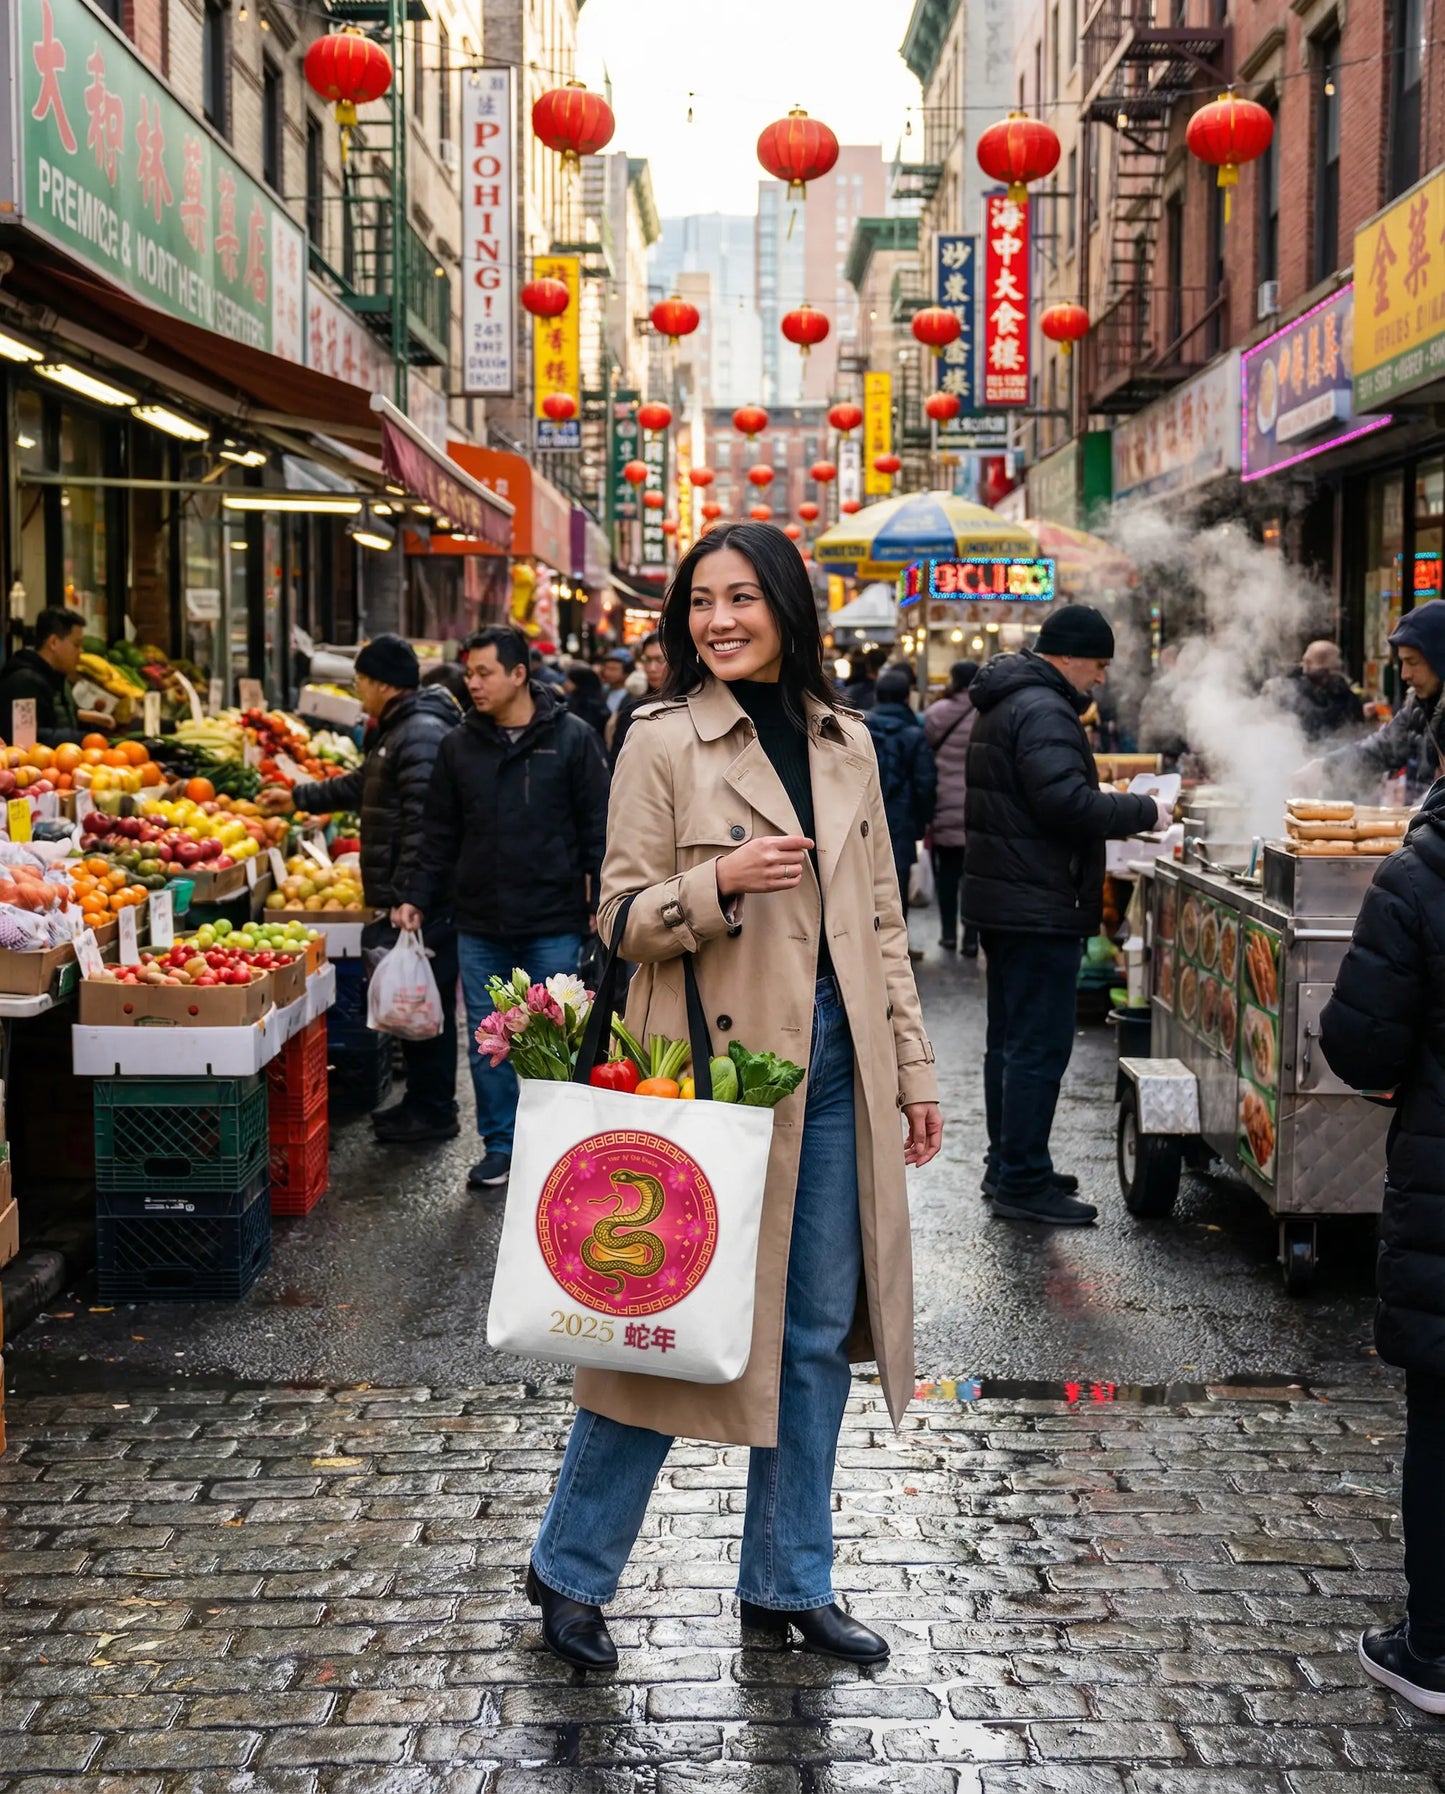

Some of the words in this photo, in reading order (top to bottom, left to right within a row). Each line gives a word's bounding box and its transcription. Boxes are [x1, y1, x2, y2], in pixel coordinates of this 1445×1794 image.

[121, 219, 132, 269] &
[472, 121, 502, 318] POHING!
[548, 1310, 615, 1343] 2025
[623, 1322, 677, 1354] 蛇年
